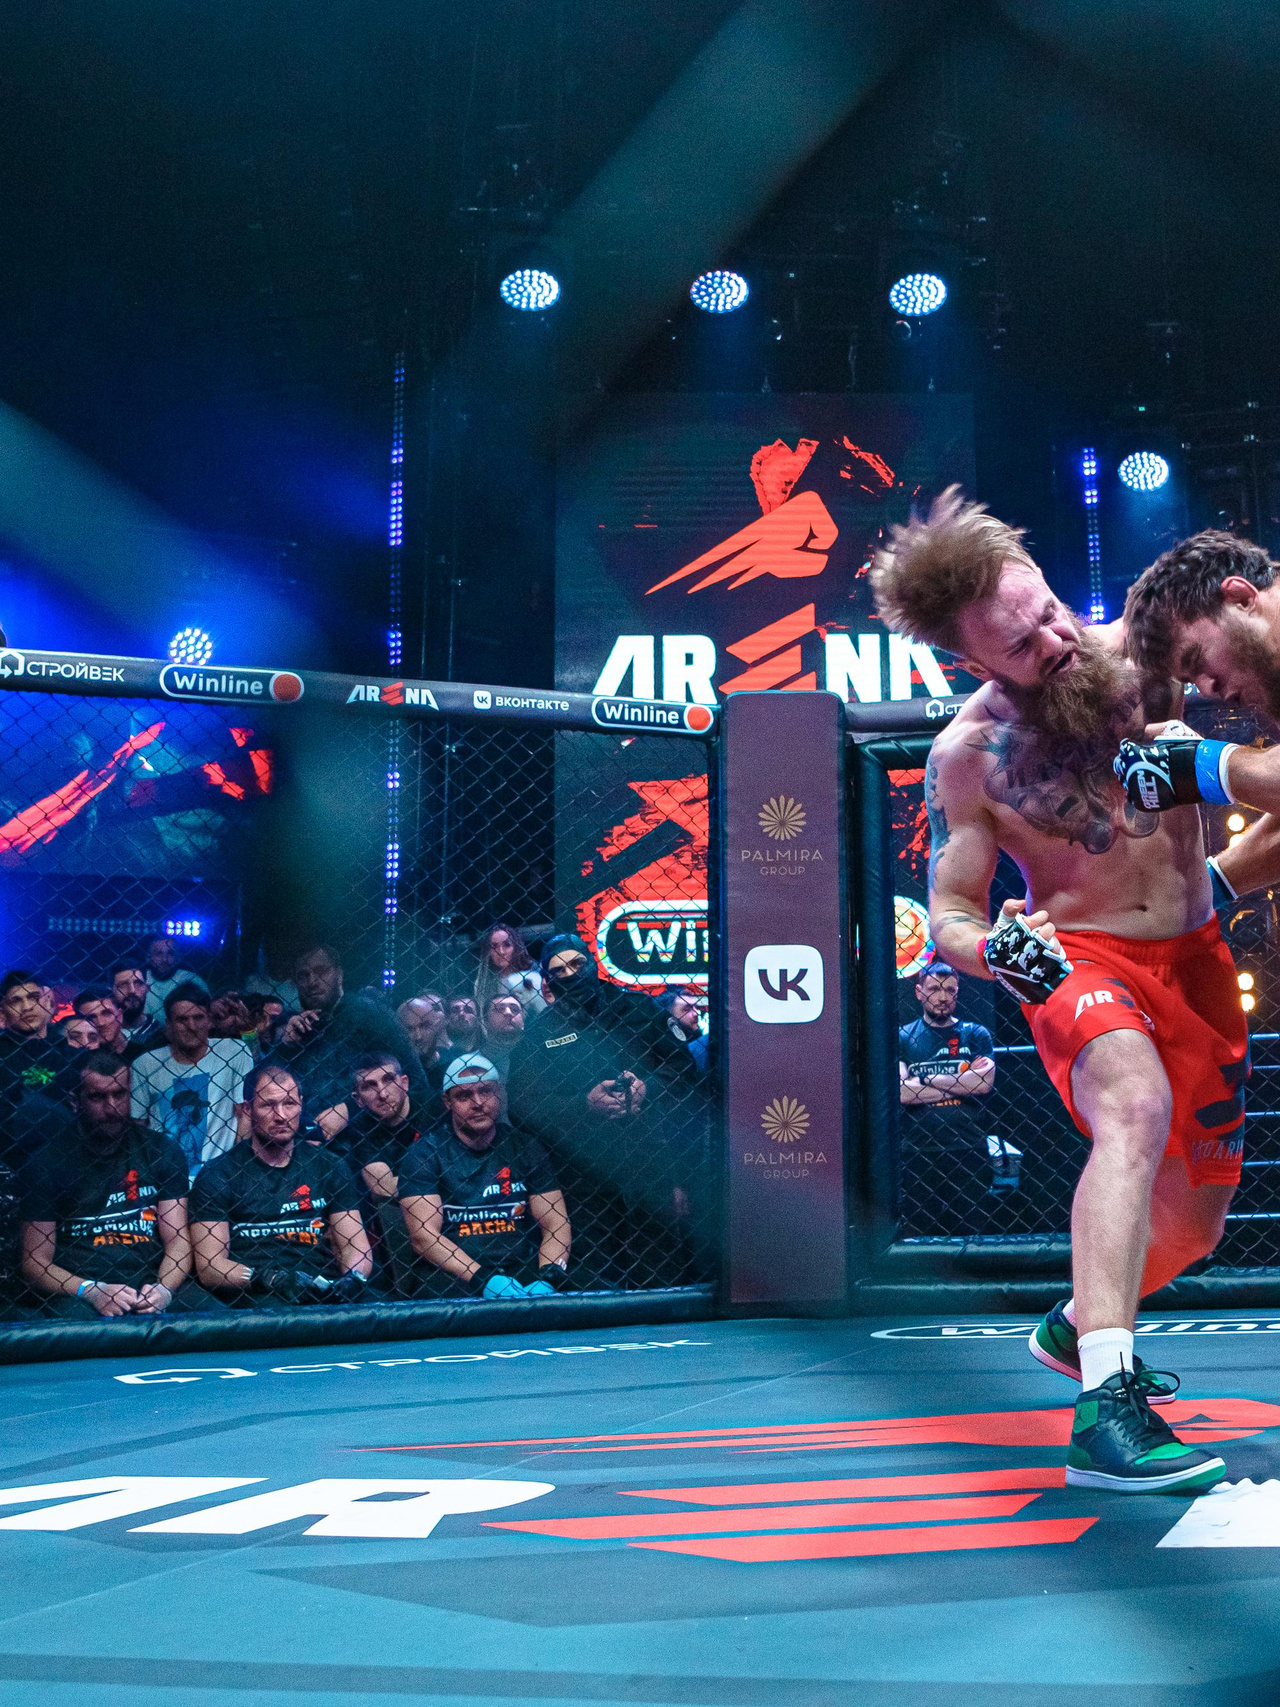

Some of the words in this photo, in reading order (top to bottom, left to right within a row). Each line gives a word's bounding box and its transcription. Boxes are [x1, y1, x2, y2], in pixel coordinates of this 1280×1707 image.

[592, 602, 953, 705] ARENA
[26, 661, 125, 682] СТРОЙВЕК
[173, 671, 264, 695] Winline
[346, 682, 439, 711] ARENA
[603, 703, 679, 724] Winline
[741, 849, 823, 862] PALMIRA
[760, 866, 806, 876] GROUP
[758, 967, 811, 1001] VK
[743, 1151, 828, 1164] PALMIRA
[763, 1169, 810, 1180] GROUP
